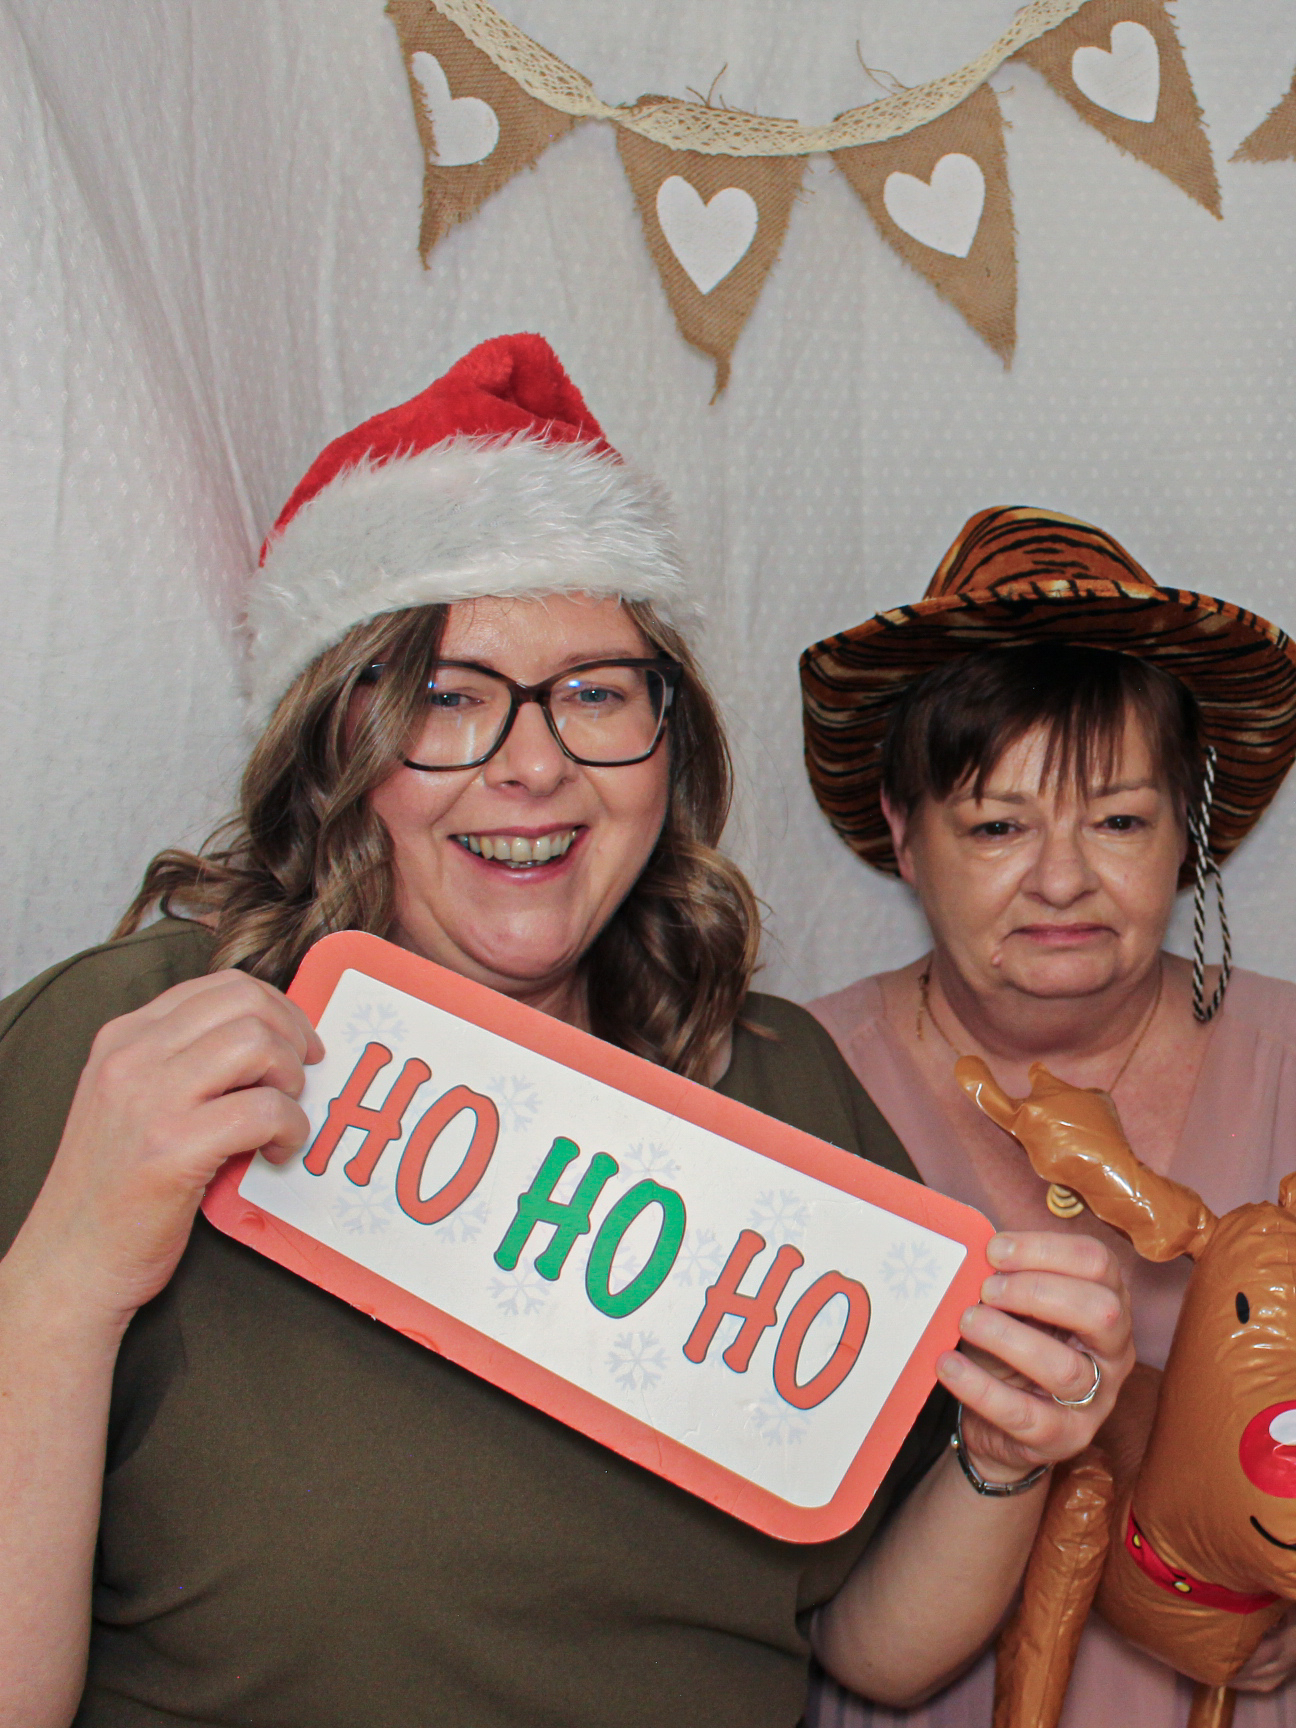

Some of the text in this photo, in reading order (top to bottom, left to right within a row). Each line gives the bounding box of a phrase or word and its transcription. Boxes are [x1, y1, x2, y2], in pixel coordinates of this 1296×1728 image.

[302, 1041, 872, 1411] HO HO HO
